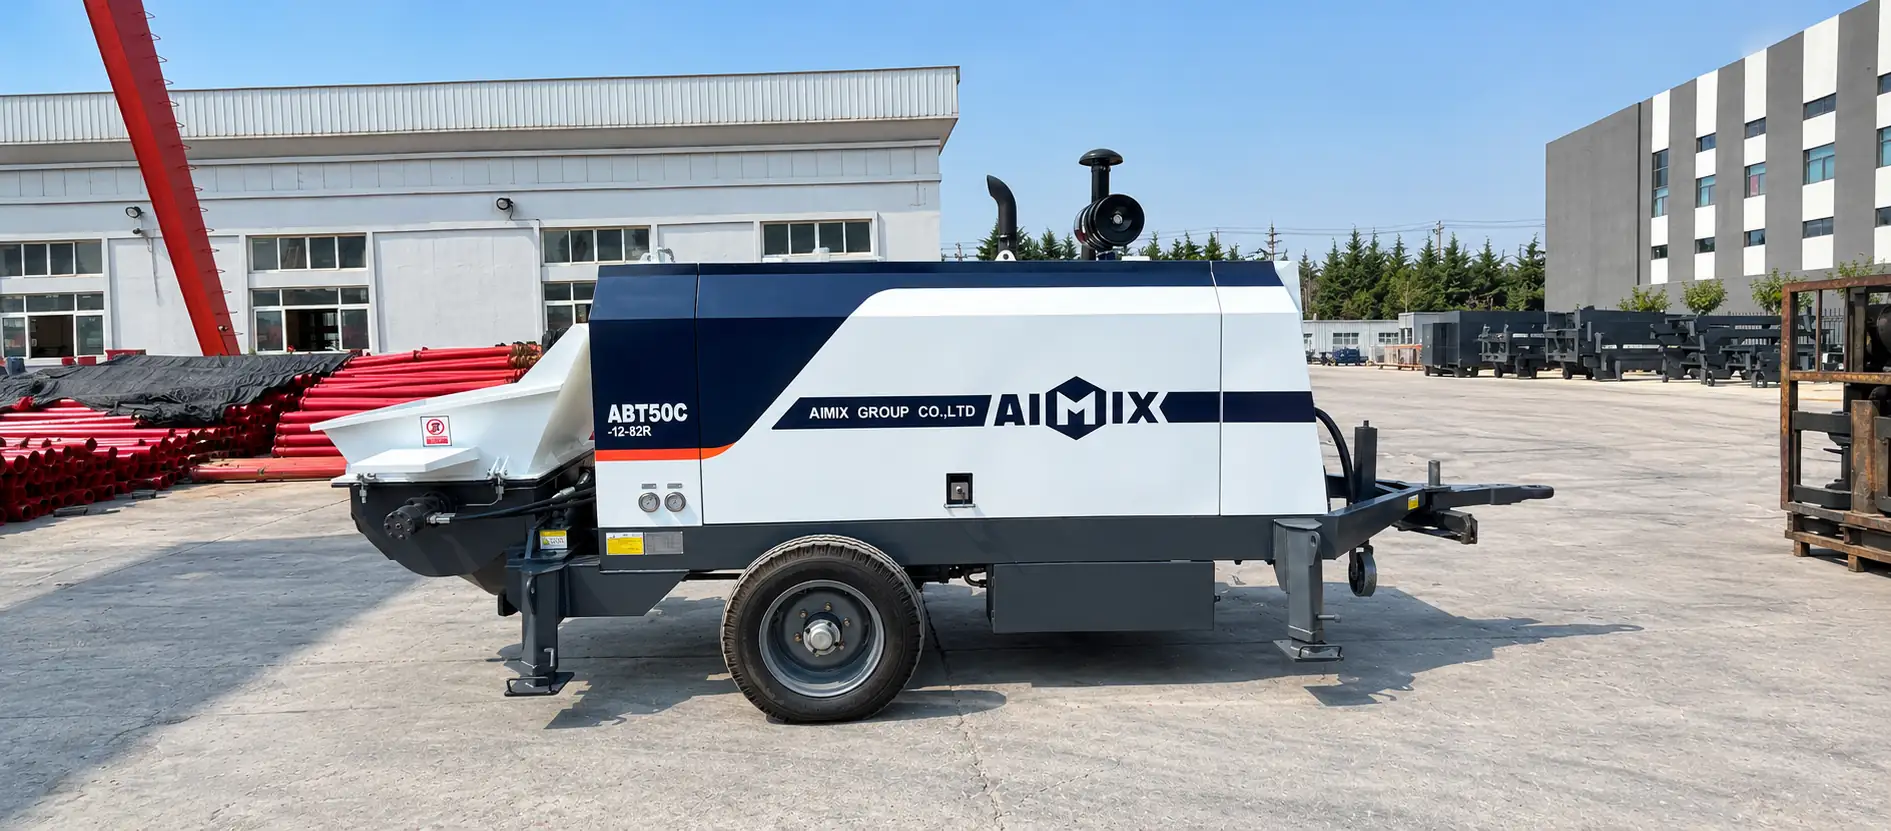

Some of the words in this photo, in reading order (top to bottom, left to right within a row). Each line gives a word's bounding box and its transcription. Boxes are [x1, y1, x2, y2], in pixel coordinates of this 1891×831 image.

[607, 402, 688, 424] ABT50C
[808, 406, 849, 420] AIMIX
[857, 405, 910, 419] GROUP
[918, 404, 976, 419] CO.,LTD
[994, 390, 1159, 428] AIMIX
[607, 425, 652, 437] -12-82R
